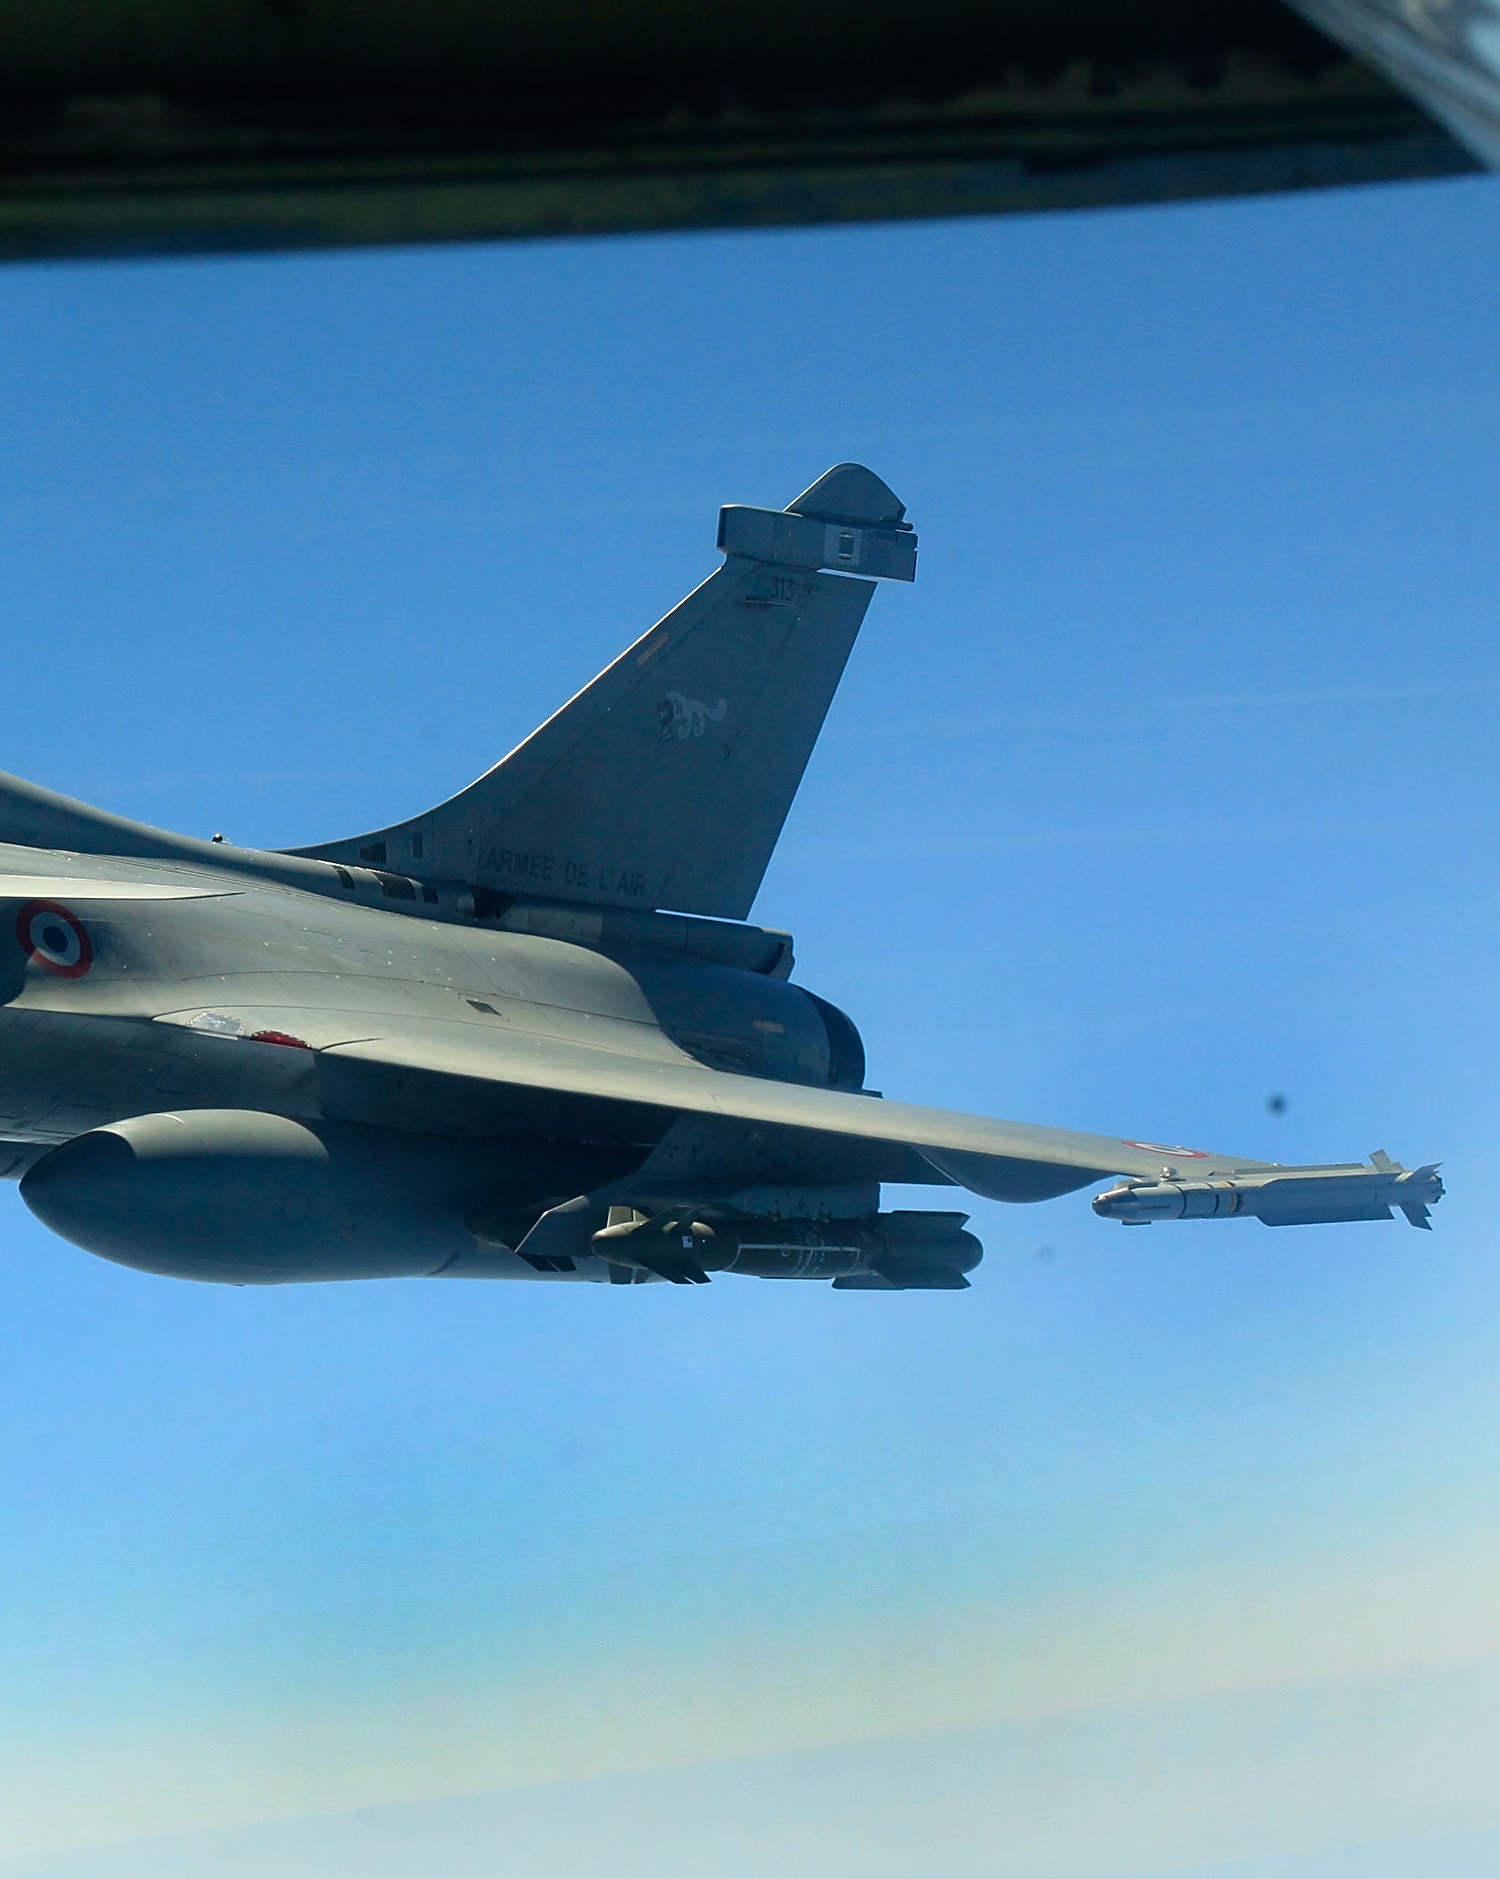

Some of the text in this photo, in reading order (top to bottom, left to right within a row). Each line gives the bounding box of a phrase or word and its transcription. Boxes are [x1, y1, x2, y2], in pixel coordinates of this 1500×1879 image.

[770, 576, 796, 601] 313
[484, 847, 556, 881] ARMEE
[564, 860, 590, 887] DE
